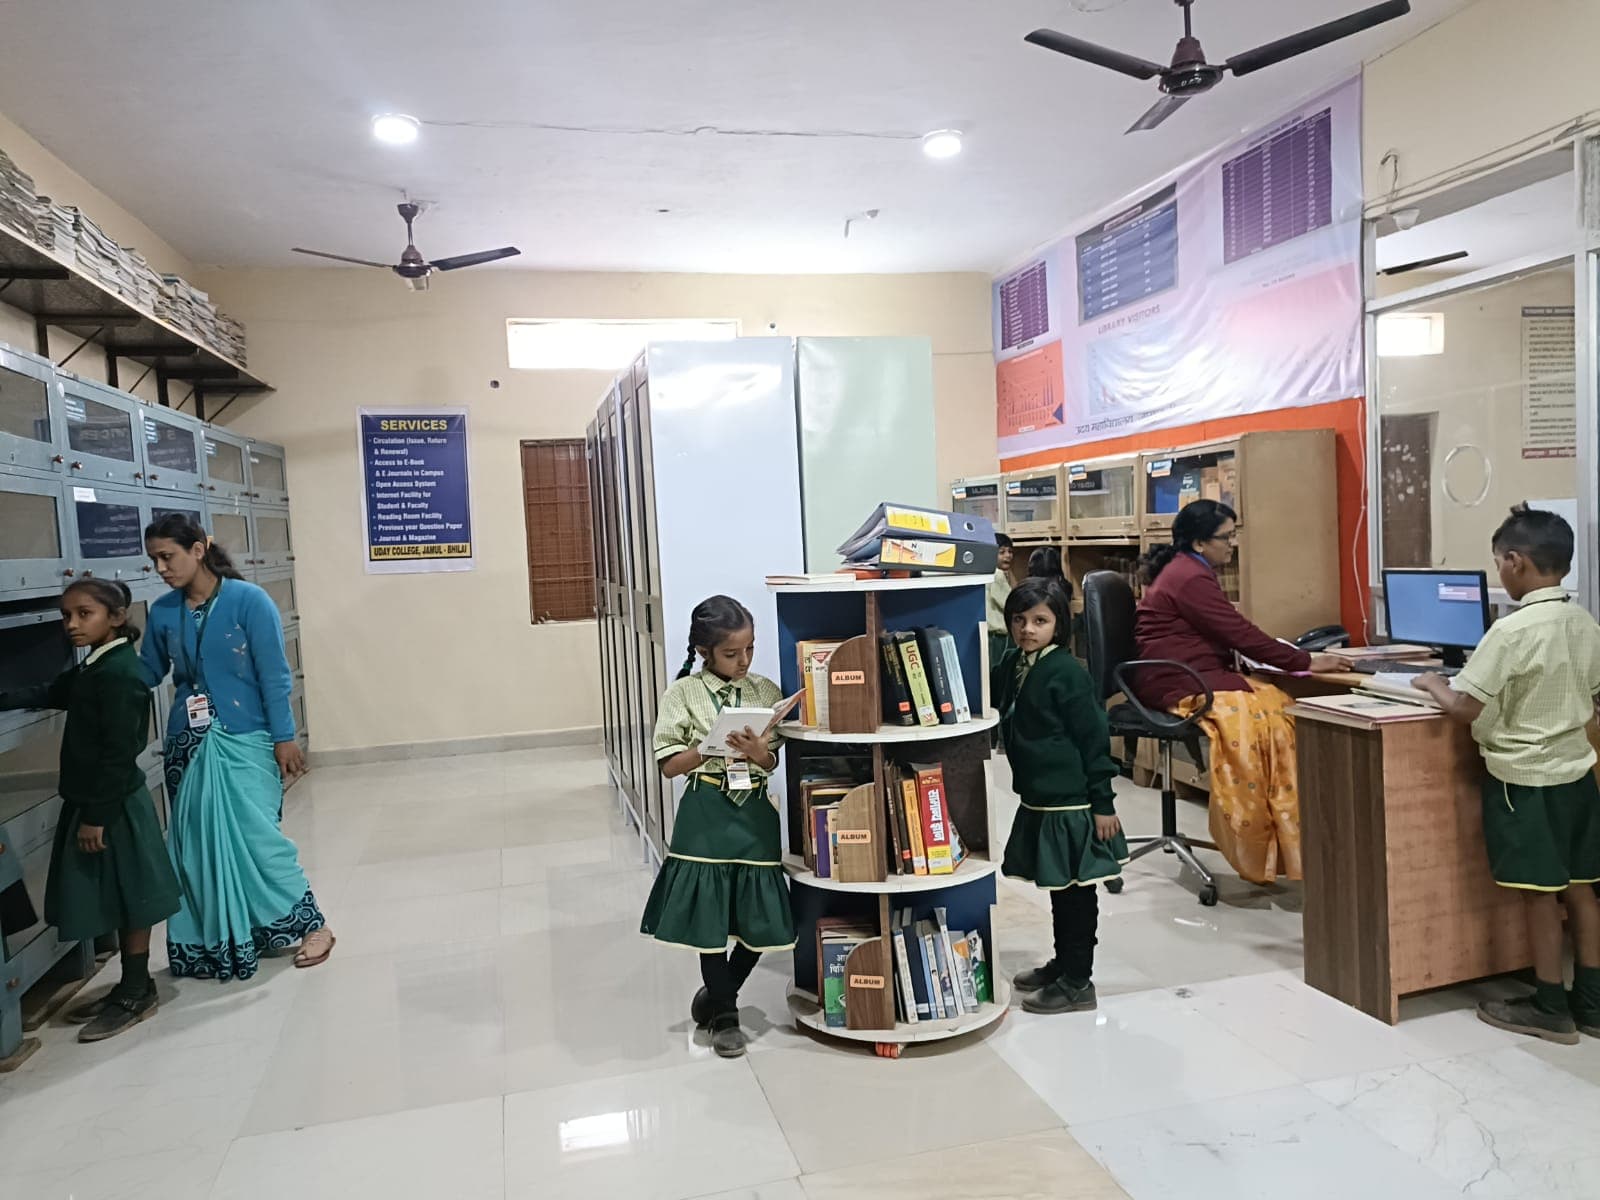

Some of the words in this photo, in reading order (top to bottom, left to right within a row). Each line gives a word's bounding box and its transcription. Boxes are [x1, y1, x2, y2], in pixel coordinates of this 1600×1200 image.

[1128, 304, 1160, 322] VISITORS
[380, 420, 448, 430] SERVICES
[380, 448, 408, 456] Renewal)
[374, 547, 392, 556] UDAY
[392, 546, 420, 556] COLLEGE,
[422, 545, 443, 554] JAMUL
[448, 544, 467, 553] BHILAI
[906, 645, 920, 670] UGC
[840, 833, 868, 841] ALBUM
